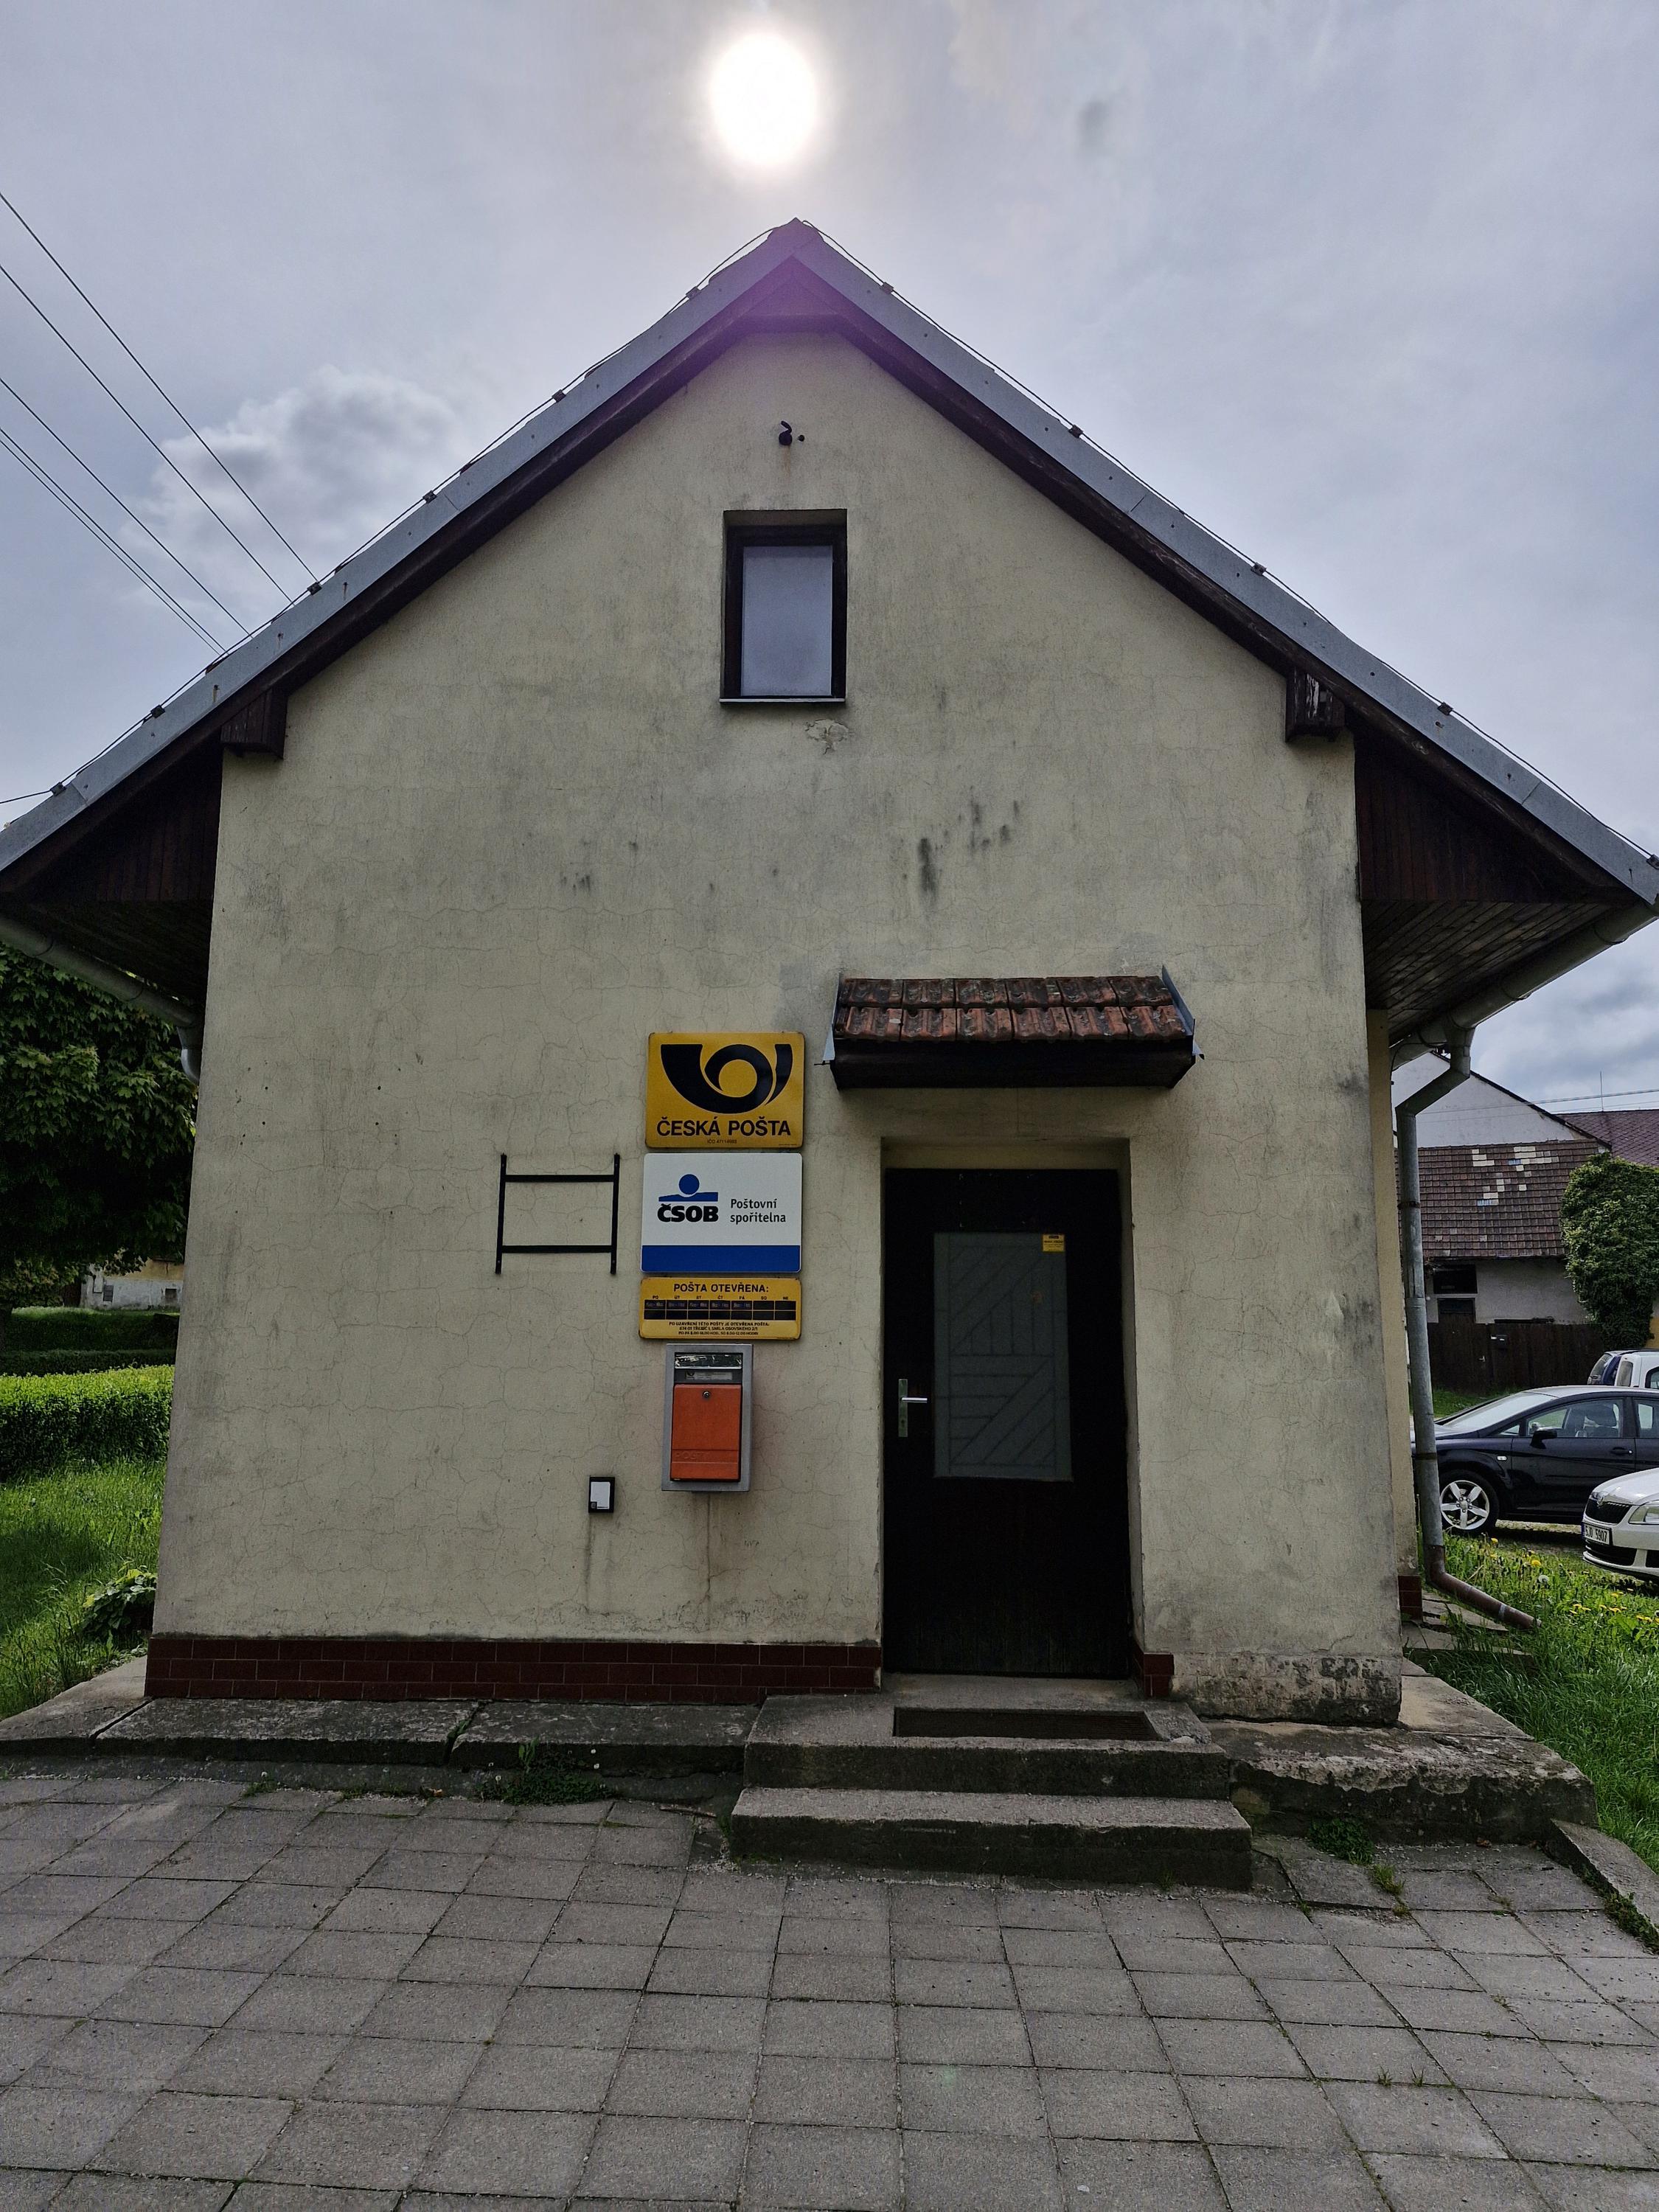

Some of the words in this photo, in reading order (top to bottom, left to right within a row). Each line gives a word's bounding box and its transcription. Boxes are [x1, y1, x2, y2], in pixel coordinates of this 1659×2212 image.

[657, 1116, 720, 1135] ČESKÁ
[728, 1116, 790, 1135] POŠTA
[730, 1198, 777, 1209] Poštovní
[657, 1203, 719, 1222] ČSOB
[729, 1211, 786, 1225] spořitelna
[673, 1281, 707, 1292] POŠTA
[710, 1281, 769, 1293] OTEVŘENA:
[1596, 1528, 1607, 1542] 5907
